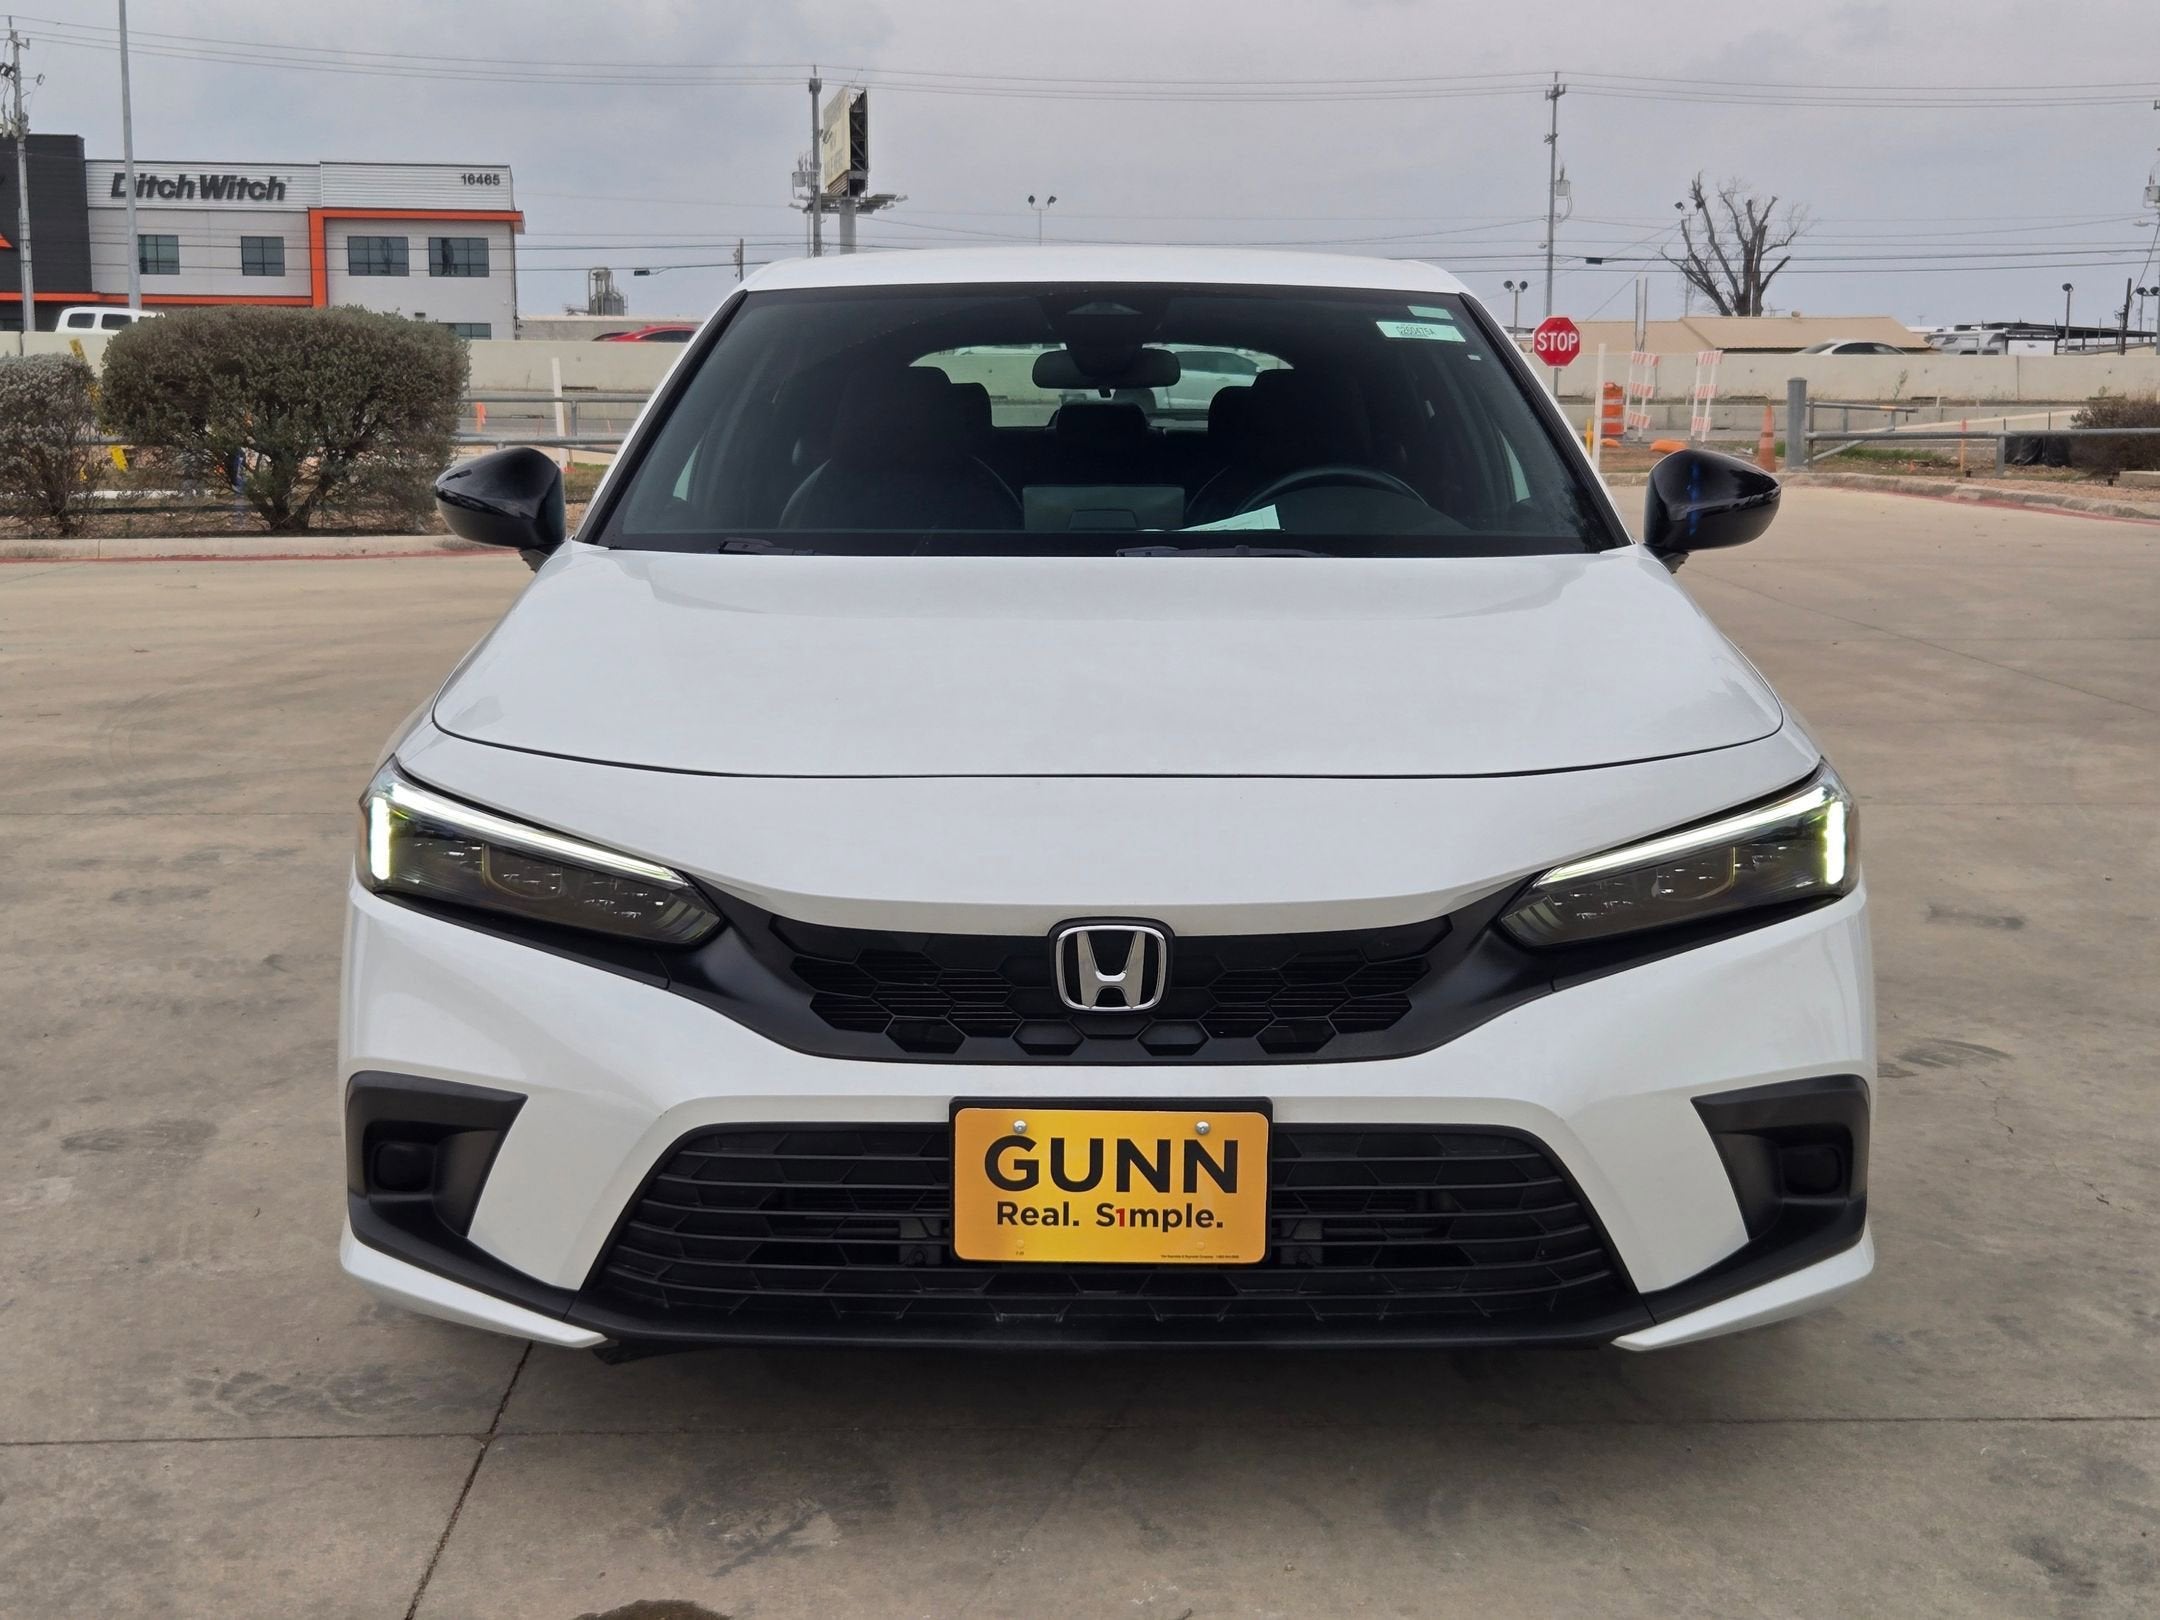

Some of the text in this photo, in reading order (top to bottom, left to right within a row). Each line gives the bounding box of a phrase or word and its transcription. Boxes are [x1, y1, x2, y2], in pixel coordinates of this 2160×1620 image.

[110, 172, 287, 201] Ditch Witch
[461, 173, 501, 186] 16465
[1537, 332, 1578, 352] STOP
[984, 1134, 1239, 1194] GUNN
[996, 1200, 1224, 1233] Real. S1mple.
